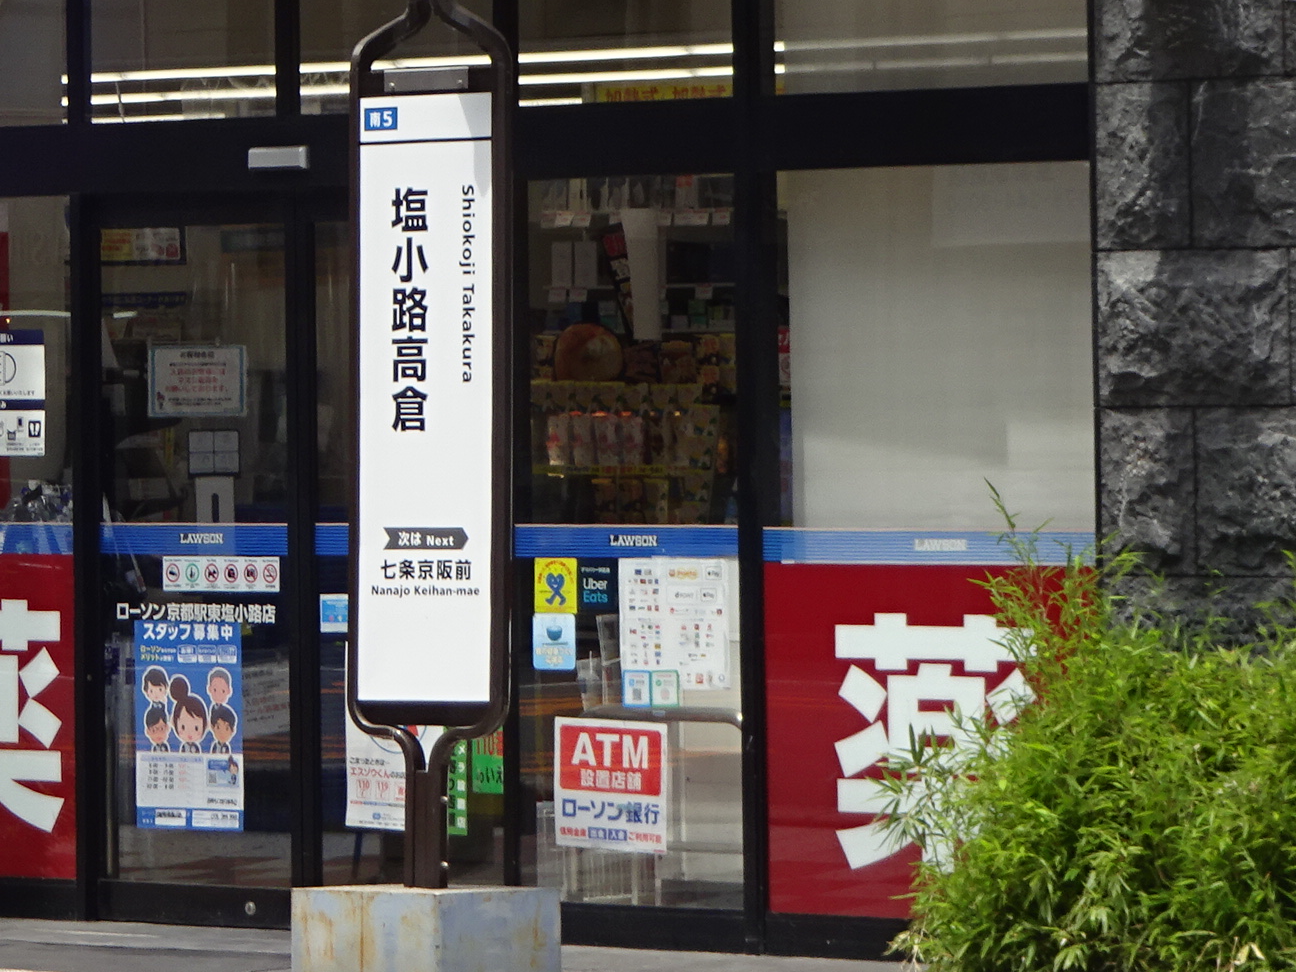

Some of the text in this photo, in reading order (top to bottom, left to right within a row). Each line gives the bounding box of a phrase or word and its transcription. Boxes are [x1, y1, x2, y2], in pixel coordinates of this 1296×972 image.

[369, 110, 393, 127] 南5
[459, 184, 475, 383] Shiokoji Takakura
[391, 187, 428, 432] 塩小路高倉
[180, 533, 224, 544] LAWSON
[398, 531, 454, 546] 次は Next
[609, 535, 658, 547] LAWSON
[381, 559, 472, 580] 七条京阪前
[371, 585, 480, 598] Nanajo Keihan-mae
[583, 577, 608, 590] Uber
[583, 591, 608, 603] Eats
[143, 623, 233, 641] スタッフ募集中
[571, 732, 649, 769] ATM
[581, 769, 642, 791] 設置店舗
[562, 798, 660, 825] ローソン銀行
